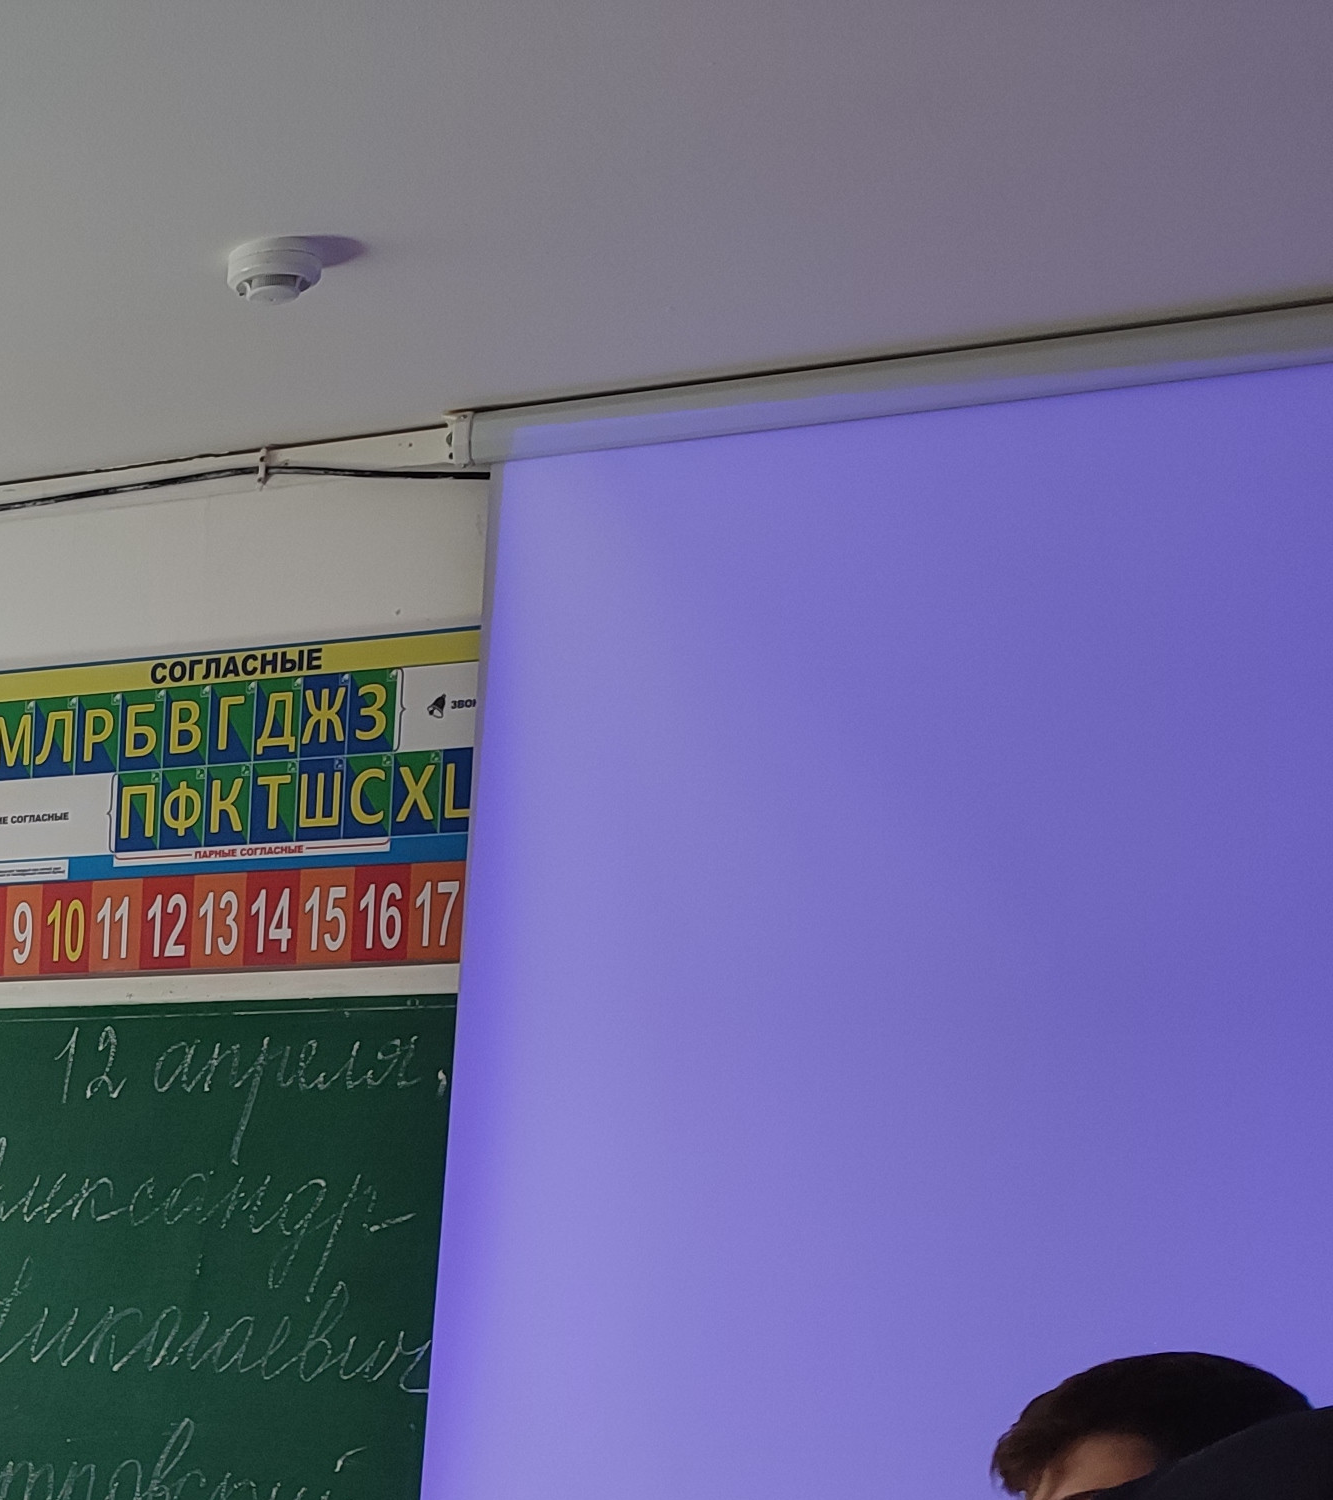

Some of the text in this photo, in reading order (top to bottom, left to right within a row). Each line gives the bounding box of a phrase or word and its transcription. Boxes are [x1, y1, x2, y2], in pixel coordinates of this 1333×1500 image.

[150, 647, 323, 684] СОГЛАСНЫЕ
[10, 811, 70, 825] СОГЛАСНЫЕ
[194, 844, 304, 860] ПАРНЫЕ СОГЛАСНЫЕ
[12, 901, 33, 964] 9
[47, 899, 85, 962] 10
[97, 896, 130, 960] 11
[147, 893, 187, 958] 12
[199, 890, 238, 956] 13
[251, 887, 292, 954] 14
[304, 886, 347, 951] 15
[359, 882, 402, 949] 16
[415, 880, 460, 947] 17
[54, 1025, 127, 1104] 12
